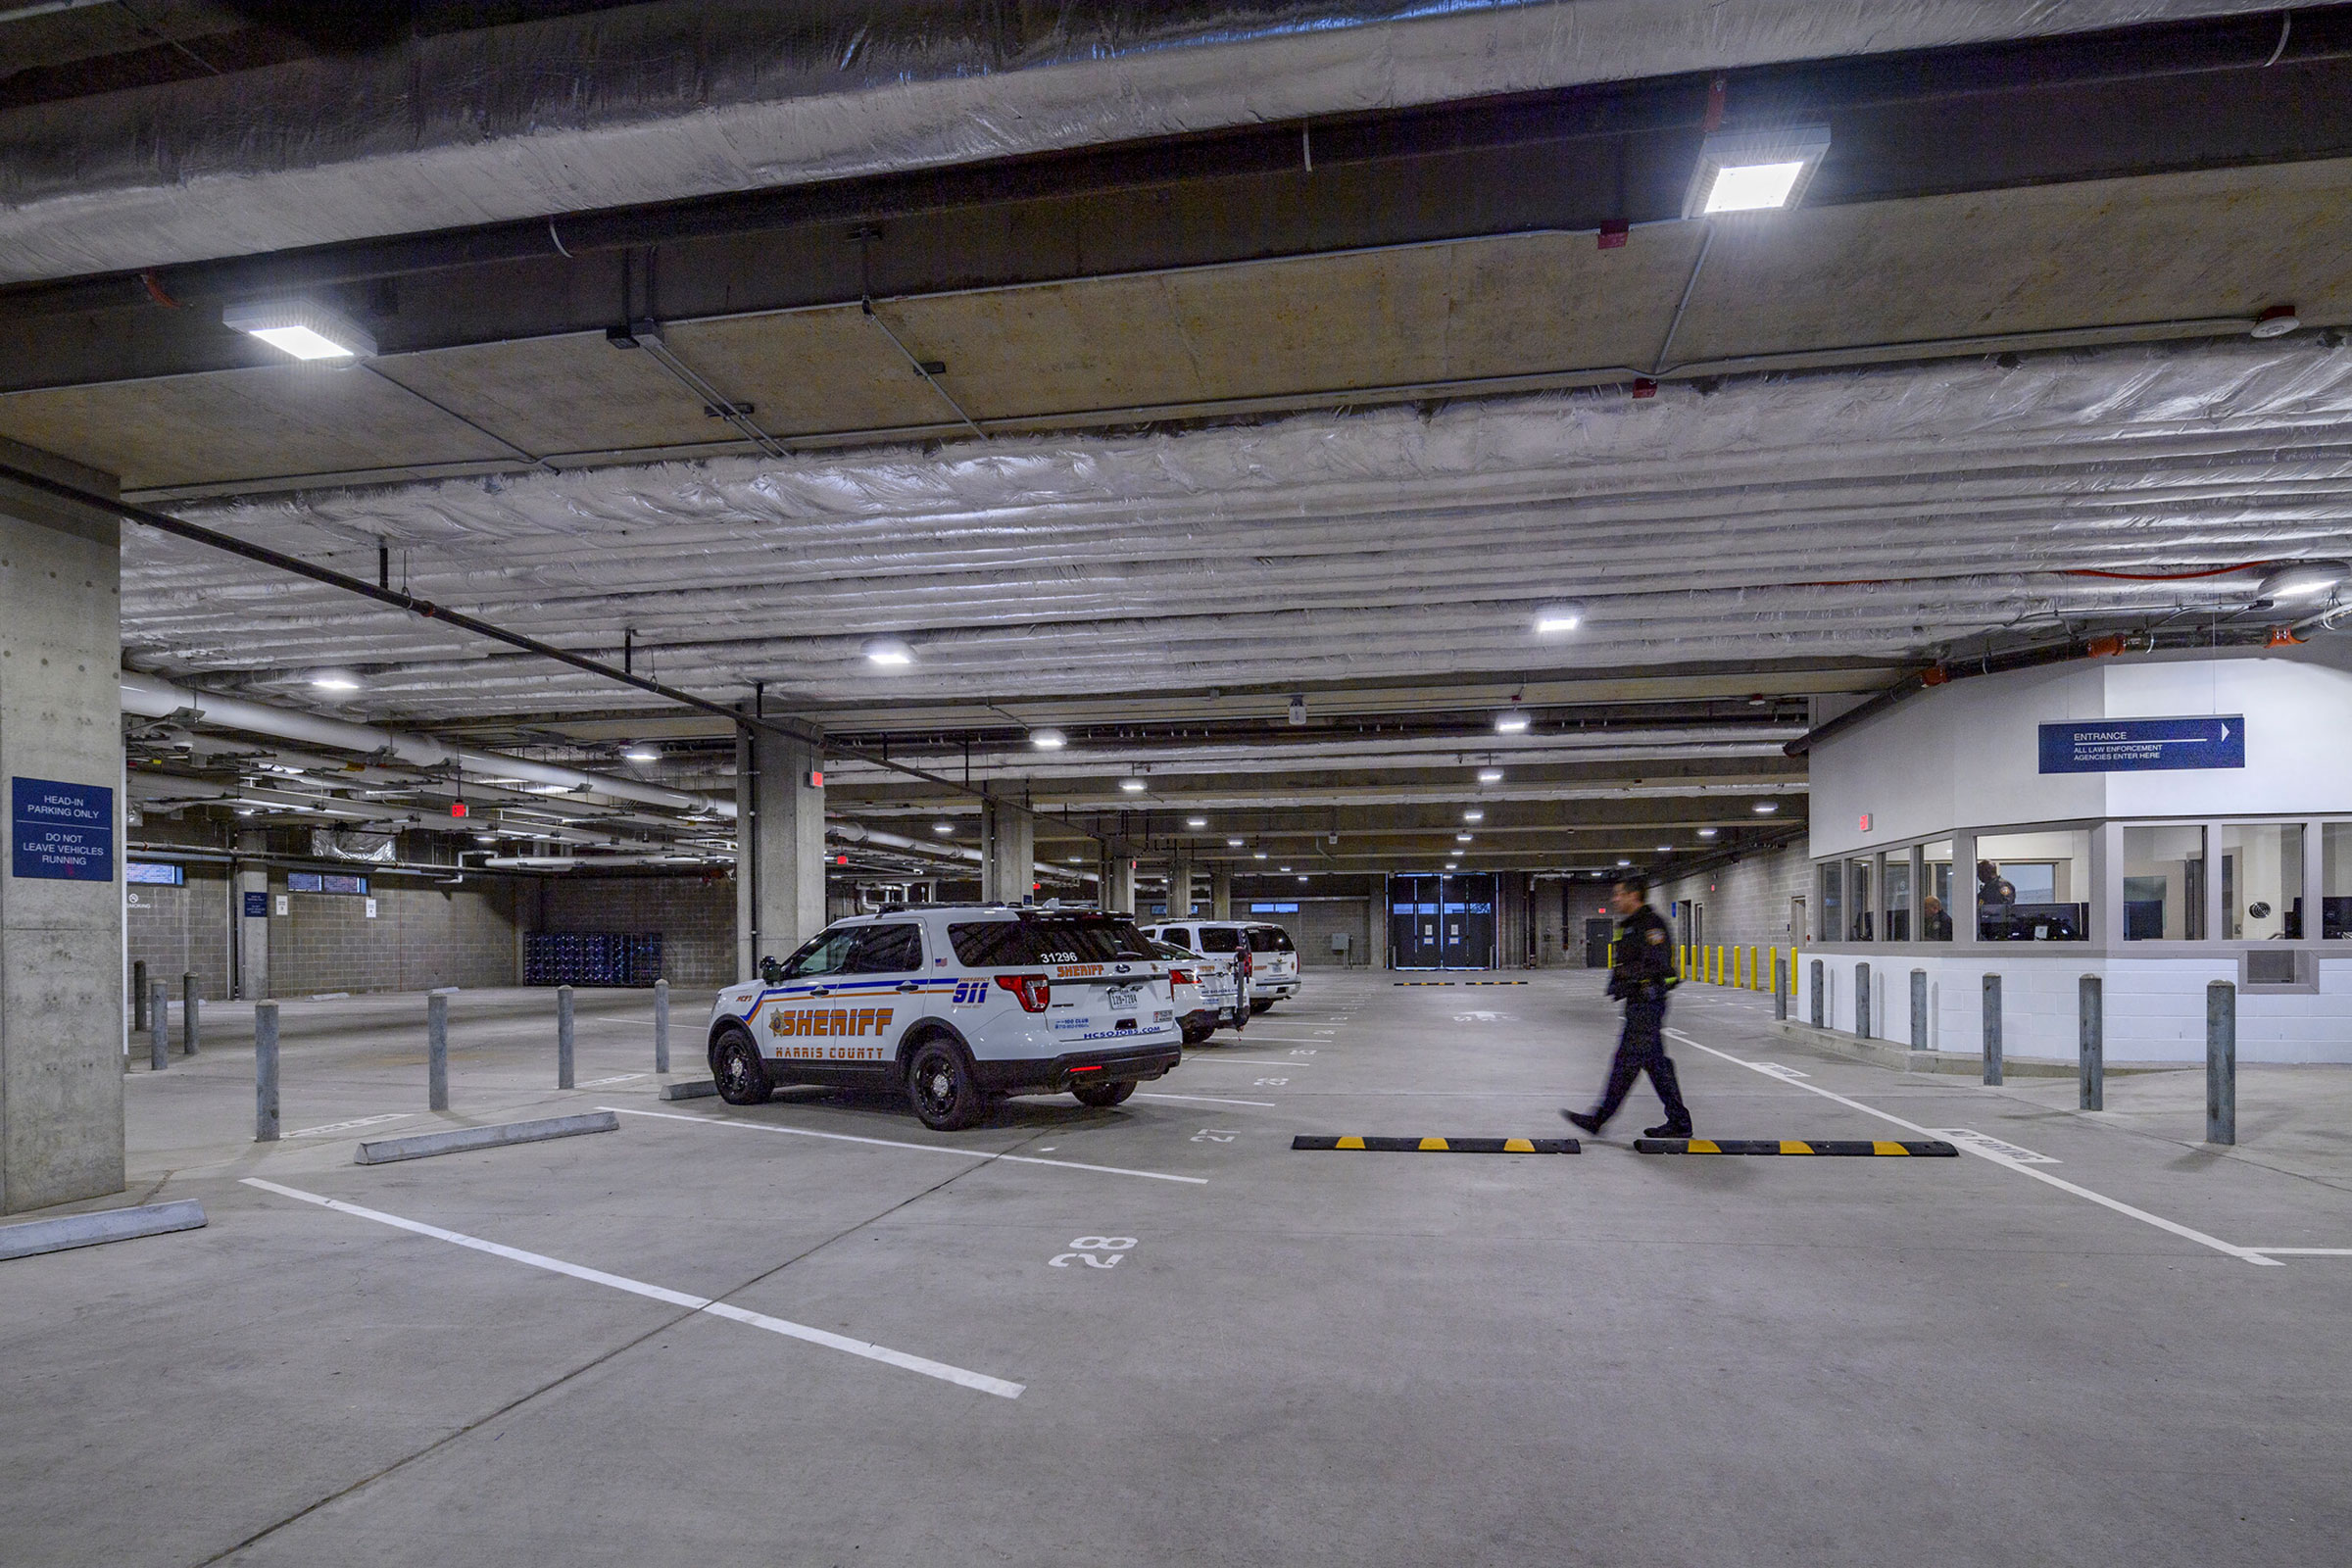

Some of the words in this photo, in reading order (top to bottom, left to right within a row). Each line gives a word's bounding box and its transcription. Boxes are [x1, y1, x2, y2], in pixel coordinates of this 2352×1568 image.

[2074, 731, 2128, 742] ENTRANCE
[43, 795, 84, 807] HEAD-IN
[27, 804, 72, 817] PARKING
[74, 808, 99, 819] ONLY
[45, 832, 61, 843] DO
[63, 834, 83, 844] NOT
[23, 842, 56, 853] LEAVE
[57, 845, 104, 856] VEHICLES
[42, 855, 87, 865] RUNNING
[1041, 952, 1078, 963] 31296
[1056, 964, 1104, 978] SHERIFF
[953, 982, 990, 1004] 911
[783, 1007, 895, 1037] SHERIFF
[1084, 1026, 1160, 1039] HCSOJOBS.COM
[775, 1047, 823, 1059] HARRIS
[829, 1047, 884, 1059] COUNTY
[1048, 1236, 1139, 1269] 28
